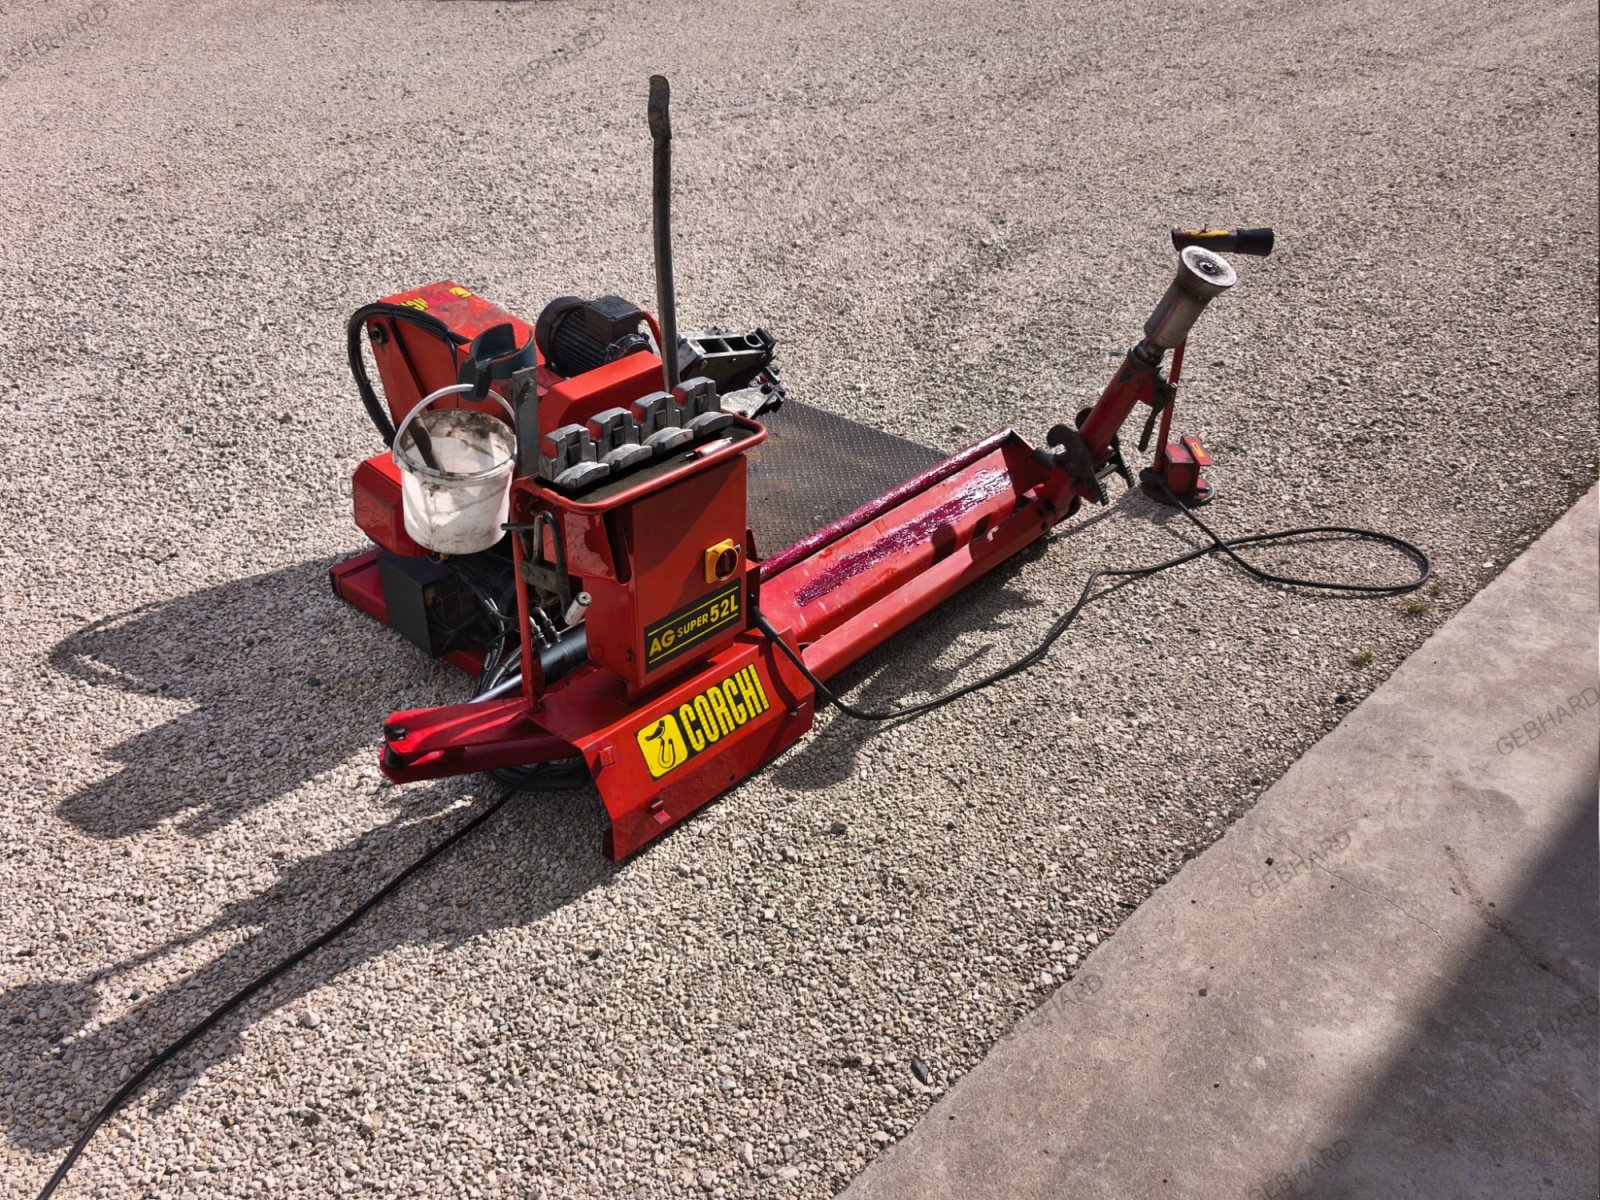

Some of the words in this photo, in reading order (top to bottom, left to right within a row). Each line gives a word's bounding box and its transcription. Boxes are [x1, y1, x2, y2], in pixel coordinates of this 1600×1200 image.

[648, 629, 676, 657] AG
[677, 612, 709, 638] SUPER
[710, 594, 739, 623] 52L
